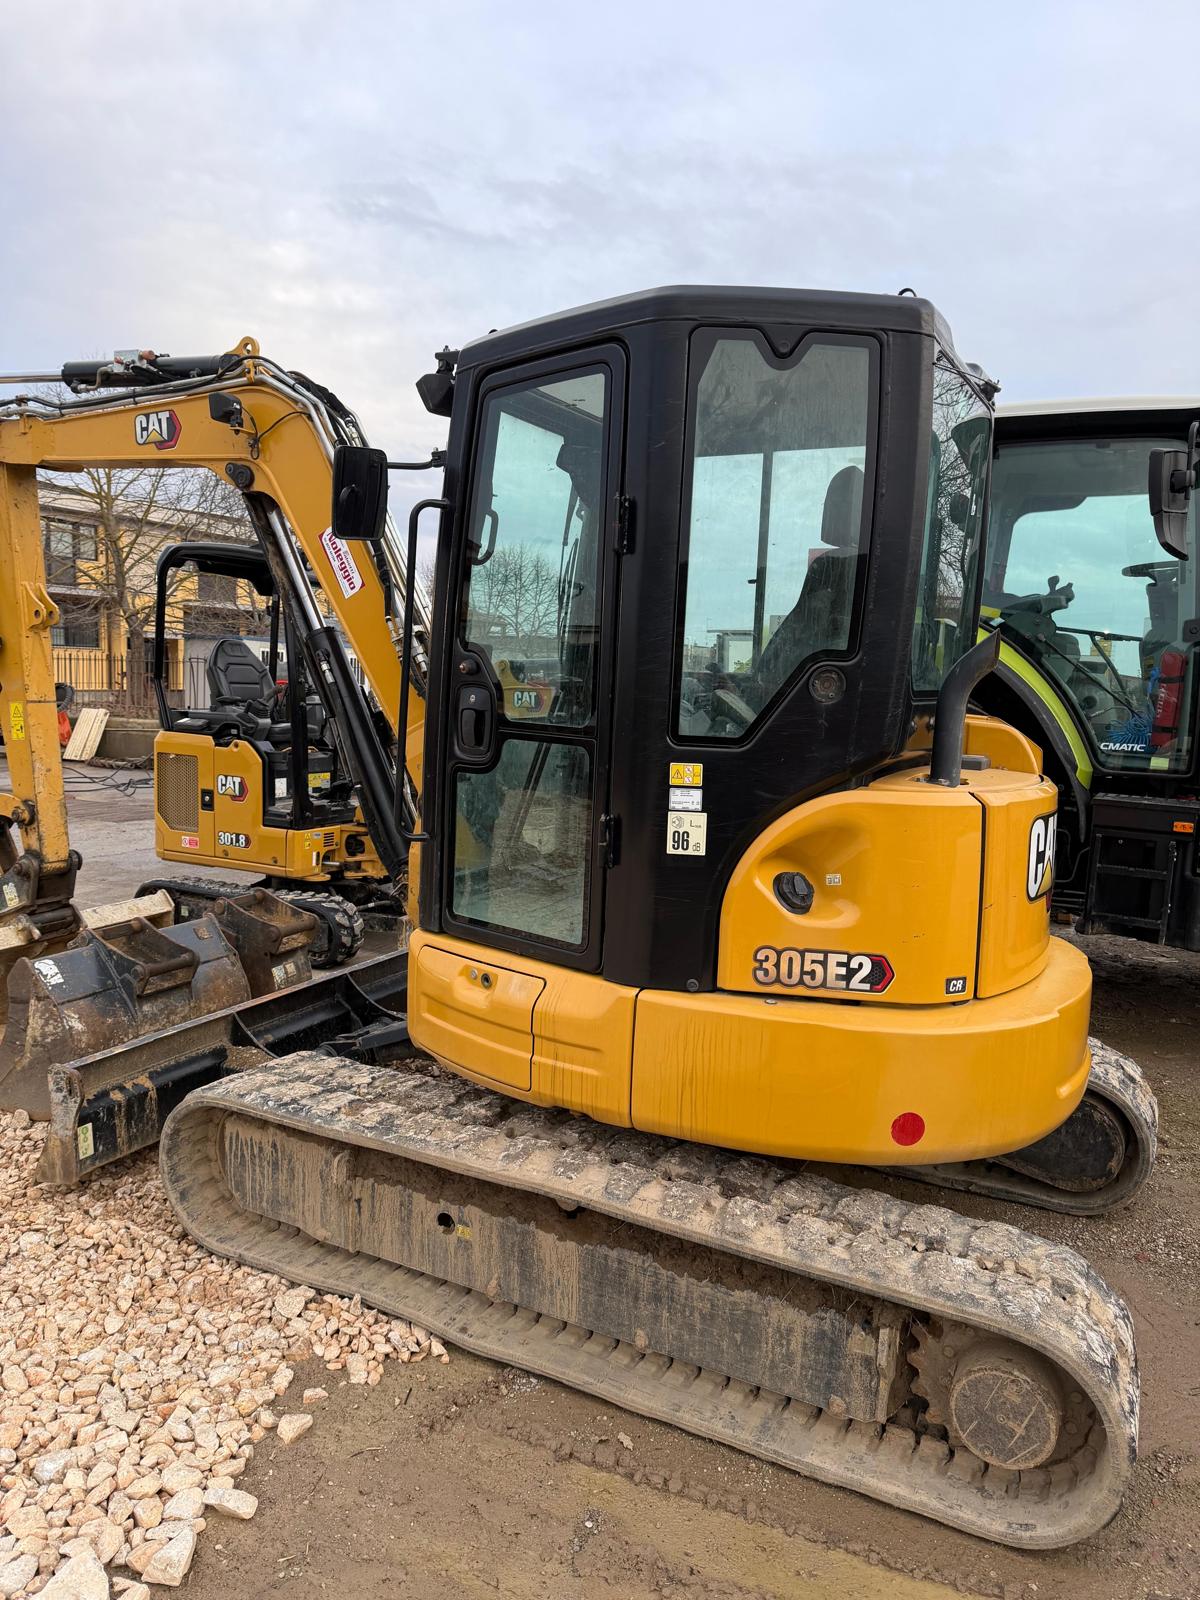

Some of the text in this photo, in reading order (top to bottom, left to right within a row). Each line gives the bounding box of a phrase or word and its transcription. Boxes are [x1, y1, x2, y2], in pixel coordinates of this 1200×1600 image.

[135, 411, 170, 445] CAT
[327, 532, 356, 591] Noleggio
[514, 691, 537, 708] CAT
[1100, 742, 1146, 752] CMATIC
[217, 774, 241, 796] CAT
[218, 831, 246, 848] 301.8
[672, 830, 701, 852] 96 dB
[756, 948, 872, 990] 305E2
[949, 978, 963, 993] CR
